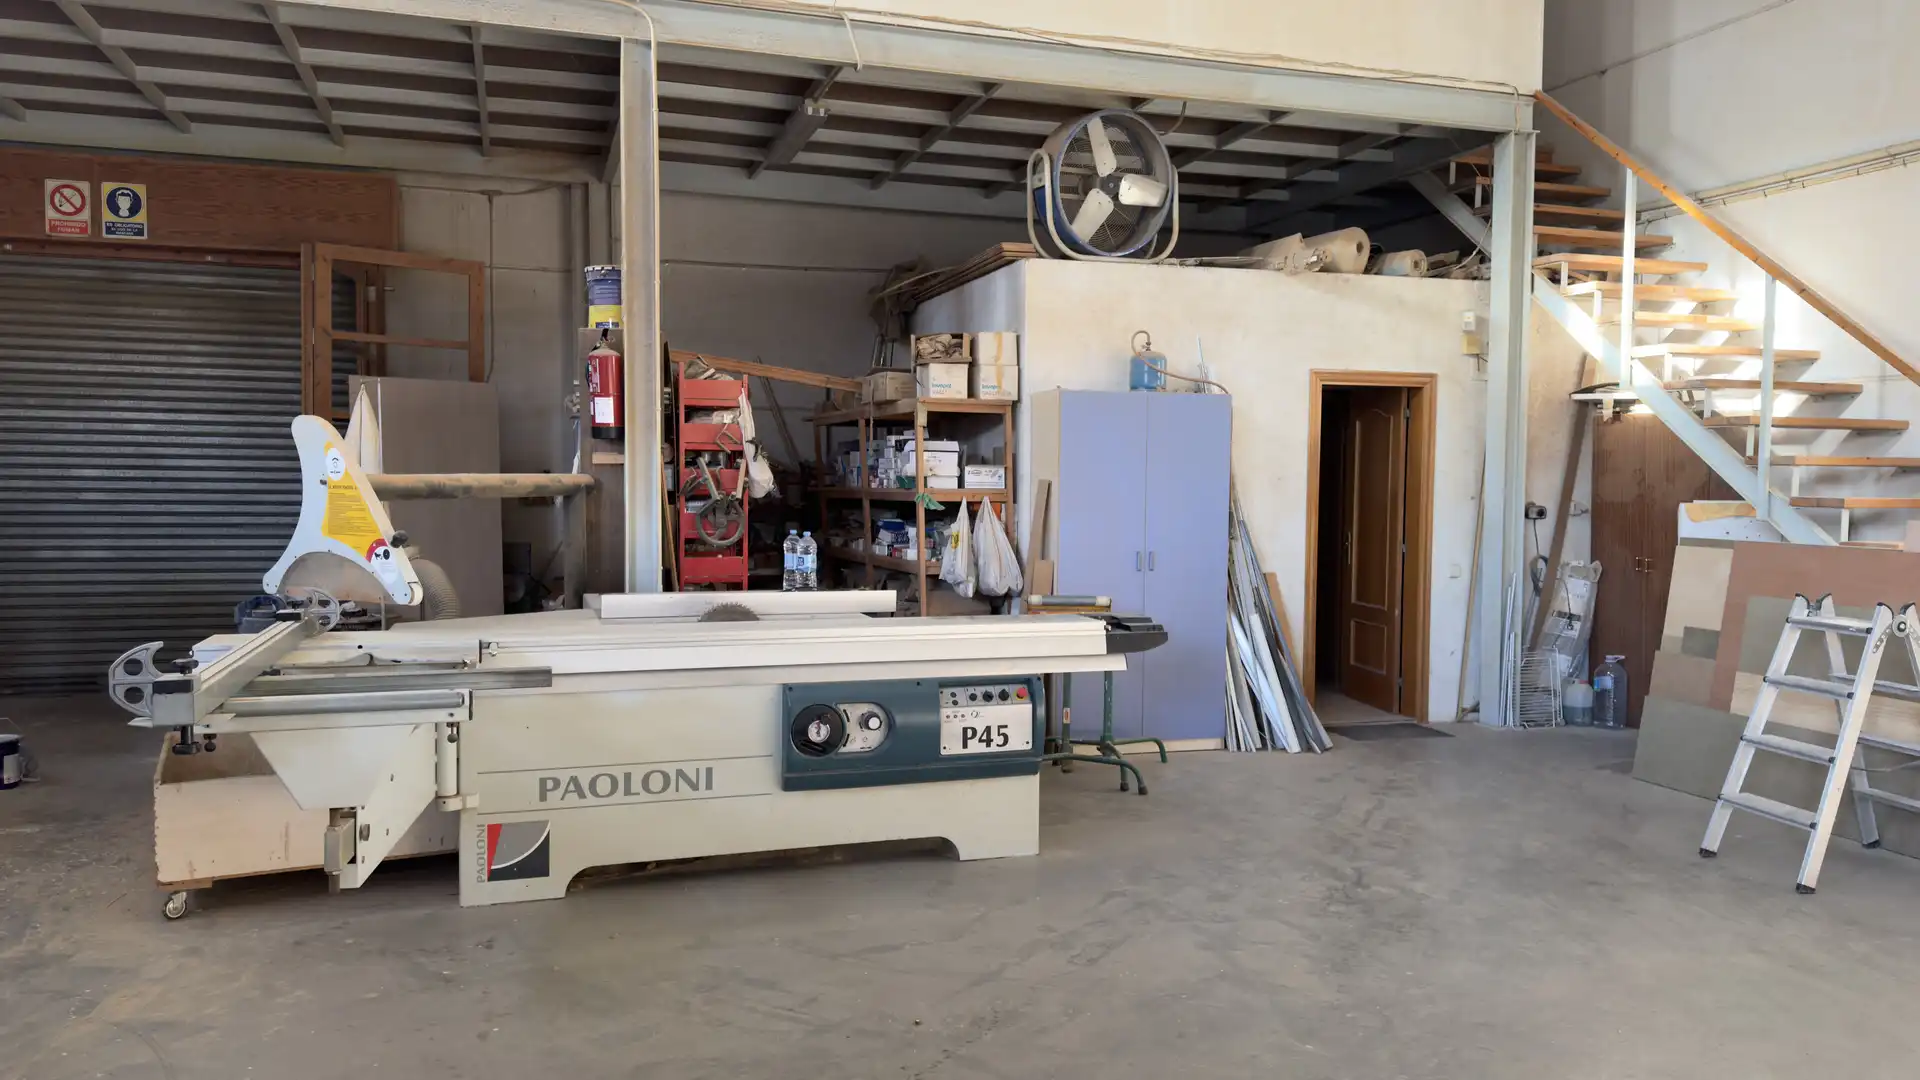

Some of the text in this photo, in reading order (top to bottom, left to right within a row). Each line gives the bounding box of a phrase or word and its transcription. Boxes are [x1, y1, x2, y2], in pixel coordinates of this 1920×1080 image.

[961, 724, 1010, 750] P45
[538, 766, 714, 803] PAOLONI
[476, 823, 486, 883] PAOLONI
